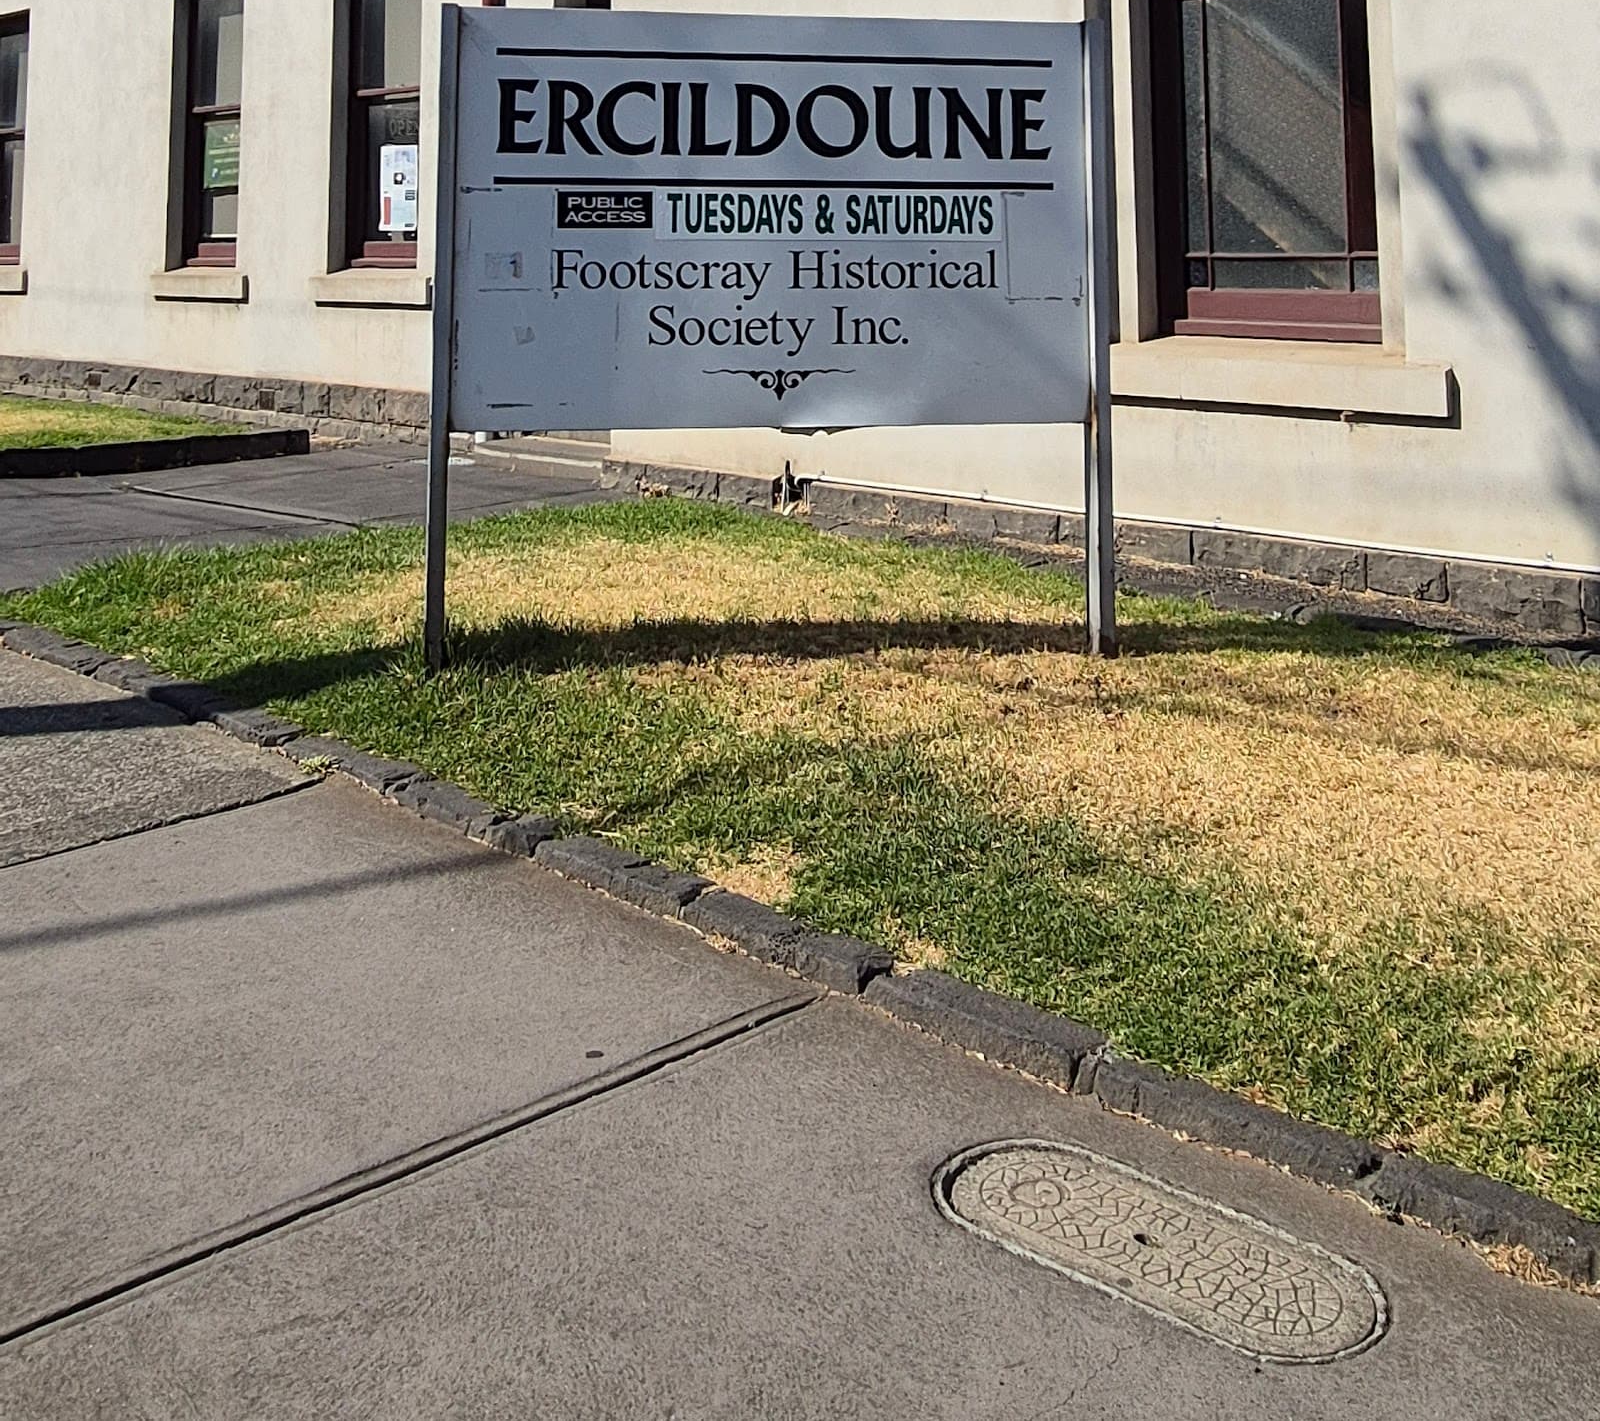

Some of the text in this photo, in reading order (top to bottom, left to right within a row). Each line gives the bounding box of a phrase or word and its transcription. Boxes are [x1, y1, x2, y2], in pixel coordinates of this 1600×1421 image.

[496, 79, 1051, 160] ERCILDOUNE
[565, 210, 646, 223] ACCESS
[567, 196, 643, 209] PUBLIC
[667, 193, 993, 235] TUESDAYS & SATURDAYS
[552, 250, 998, 300] Footscray Historical
[648, 305, 909, 356] Society Inc.
